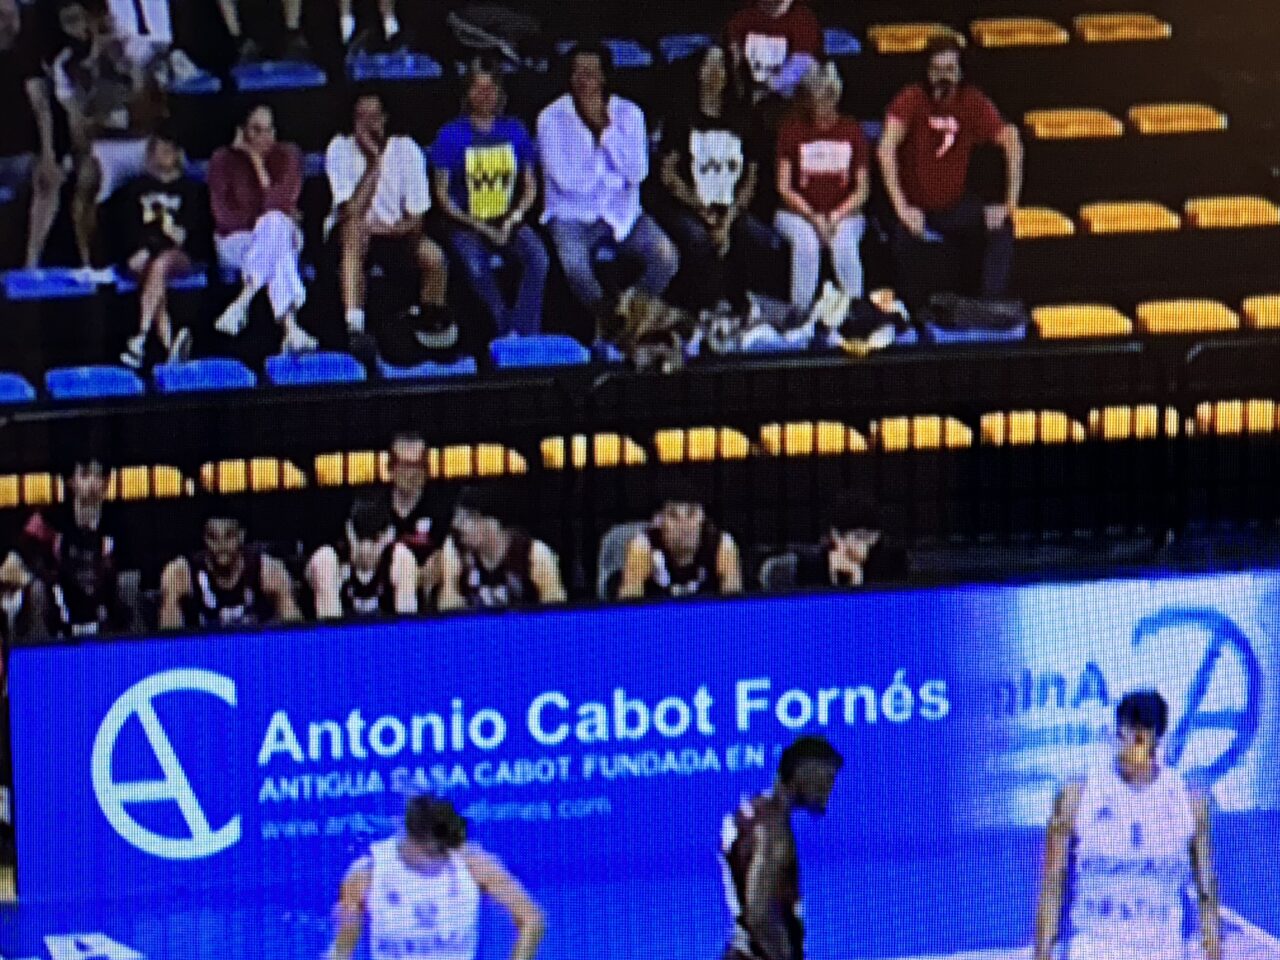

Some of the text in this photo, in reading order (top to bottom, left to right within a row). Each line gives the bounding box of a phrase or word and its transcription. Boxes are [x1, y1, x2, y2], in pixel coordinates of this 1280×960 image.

[258, 668, 951, 766] Antonio Cabot Fornés
[259, 770, 384, 803] ANTIGUA
[474, 756, 572, 788] CABOT
[583, 746, 720, 780] FUNDADA
